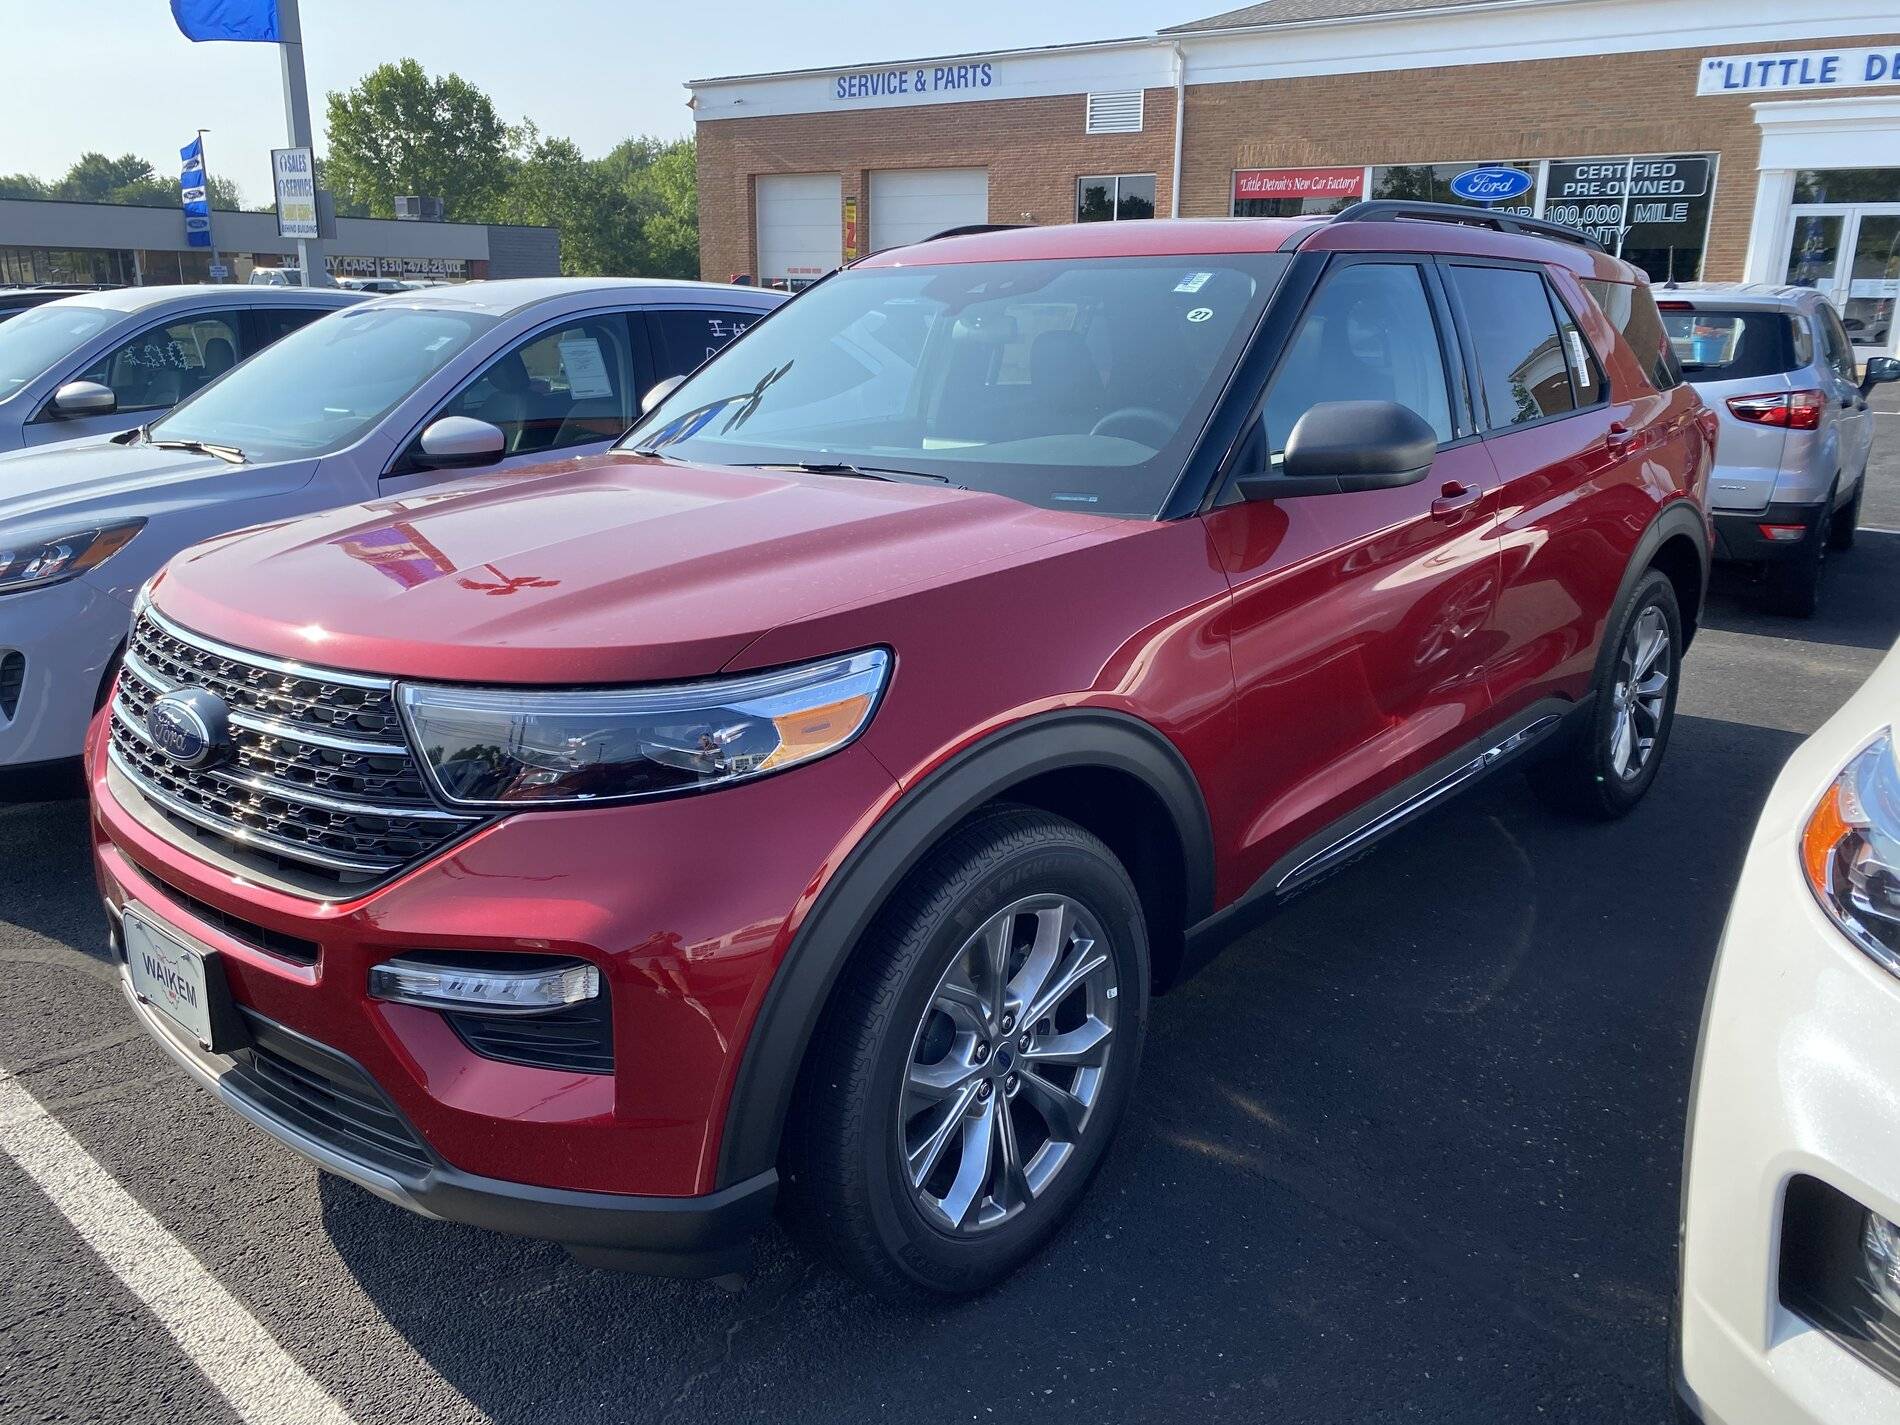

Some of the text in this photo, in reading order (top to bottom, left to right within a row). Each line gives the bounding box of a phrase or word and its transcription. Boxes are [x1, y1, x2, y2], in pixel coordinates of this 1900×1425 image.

[837, 63, 992, 99] SERVICE & PARTS
[287, 155, 307, 172] SALES
[286, 179, 313, 197] SERVICE
[1294, 177, 1311, 190] New
[1312, 176, 1326, 190] Car
[1467, 172, 1513, 193] Ford
[1563, 179, 1685, 196] PRE-OWNED
[1633, 203, 1689, 222] MILE
[344, 258, 375, 271] CARS
[1189, 310, 1212, 321] 27
[142, 951, 198, 1009] WAIKEM
